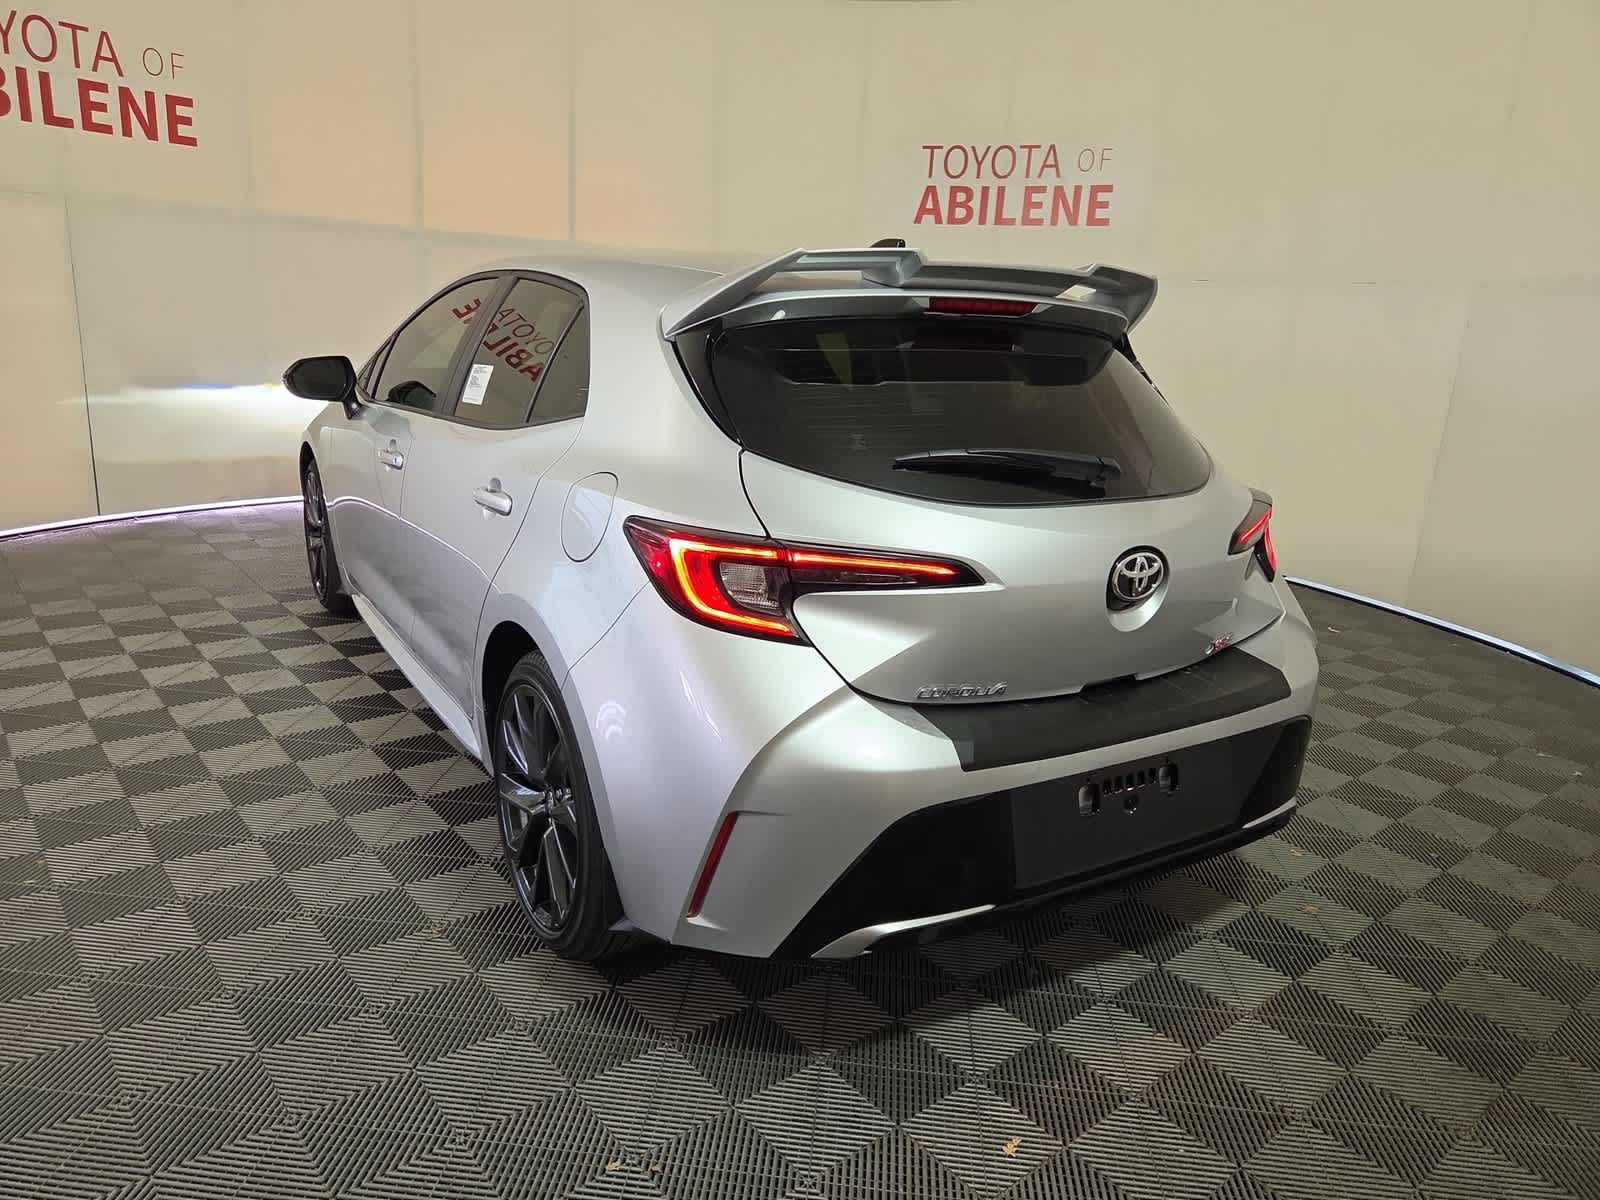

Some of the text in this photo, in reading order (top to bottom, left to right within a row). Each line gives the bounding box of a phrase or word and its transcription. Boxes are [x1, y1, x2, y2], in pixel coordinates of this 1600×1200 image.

[142, 47, 185, 80] OF
[922, 143, 1114, 179] TOYOTA OF
[913, 184, 1114, 226] ABILENE
